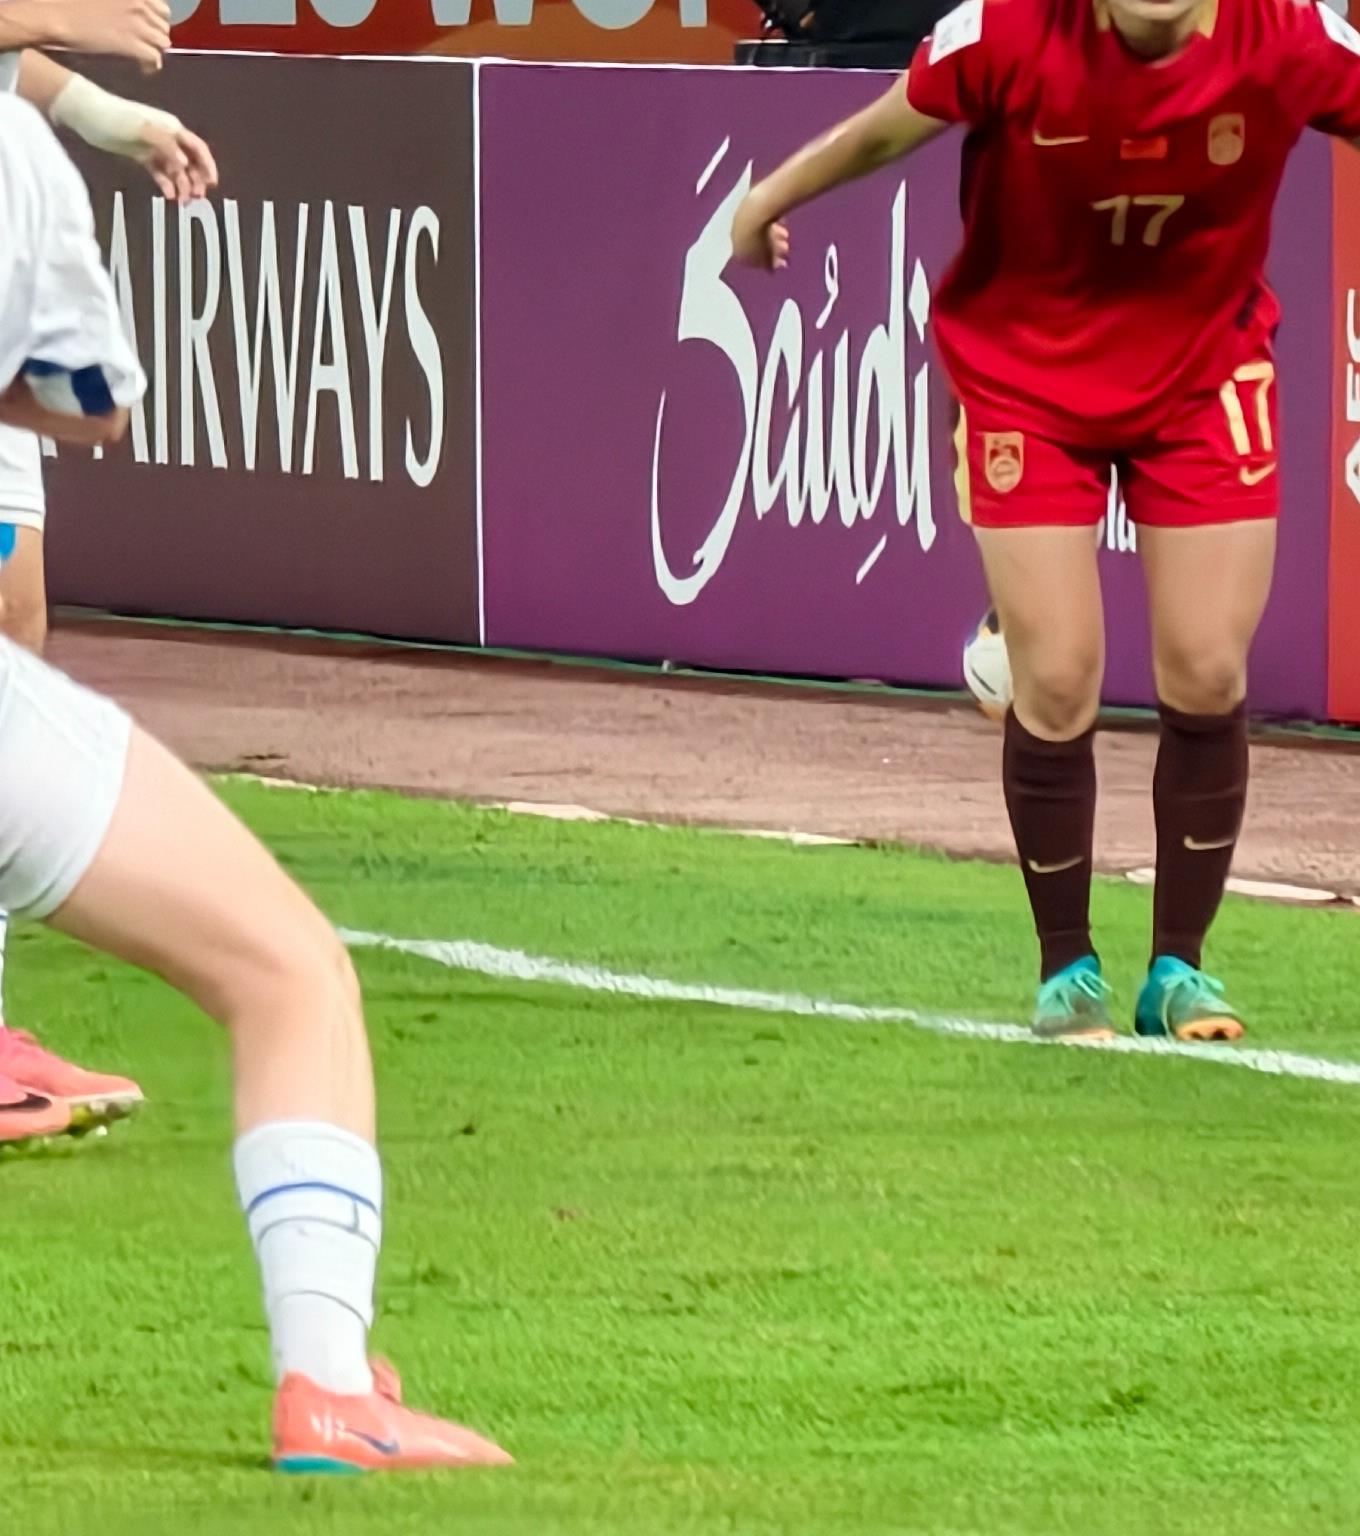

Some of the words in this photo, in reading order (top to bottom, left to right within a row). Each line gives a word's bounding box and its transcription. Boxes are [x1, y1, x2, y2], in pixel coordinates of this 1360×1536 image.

[1092, 194, 1186, 247] 17
[92, 190, 444, 488] AIRWAYS
[1221, 360, 1274, 455] 17
